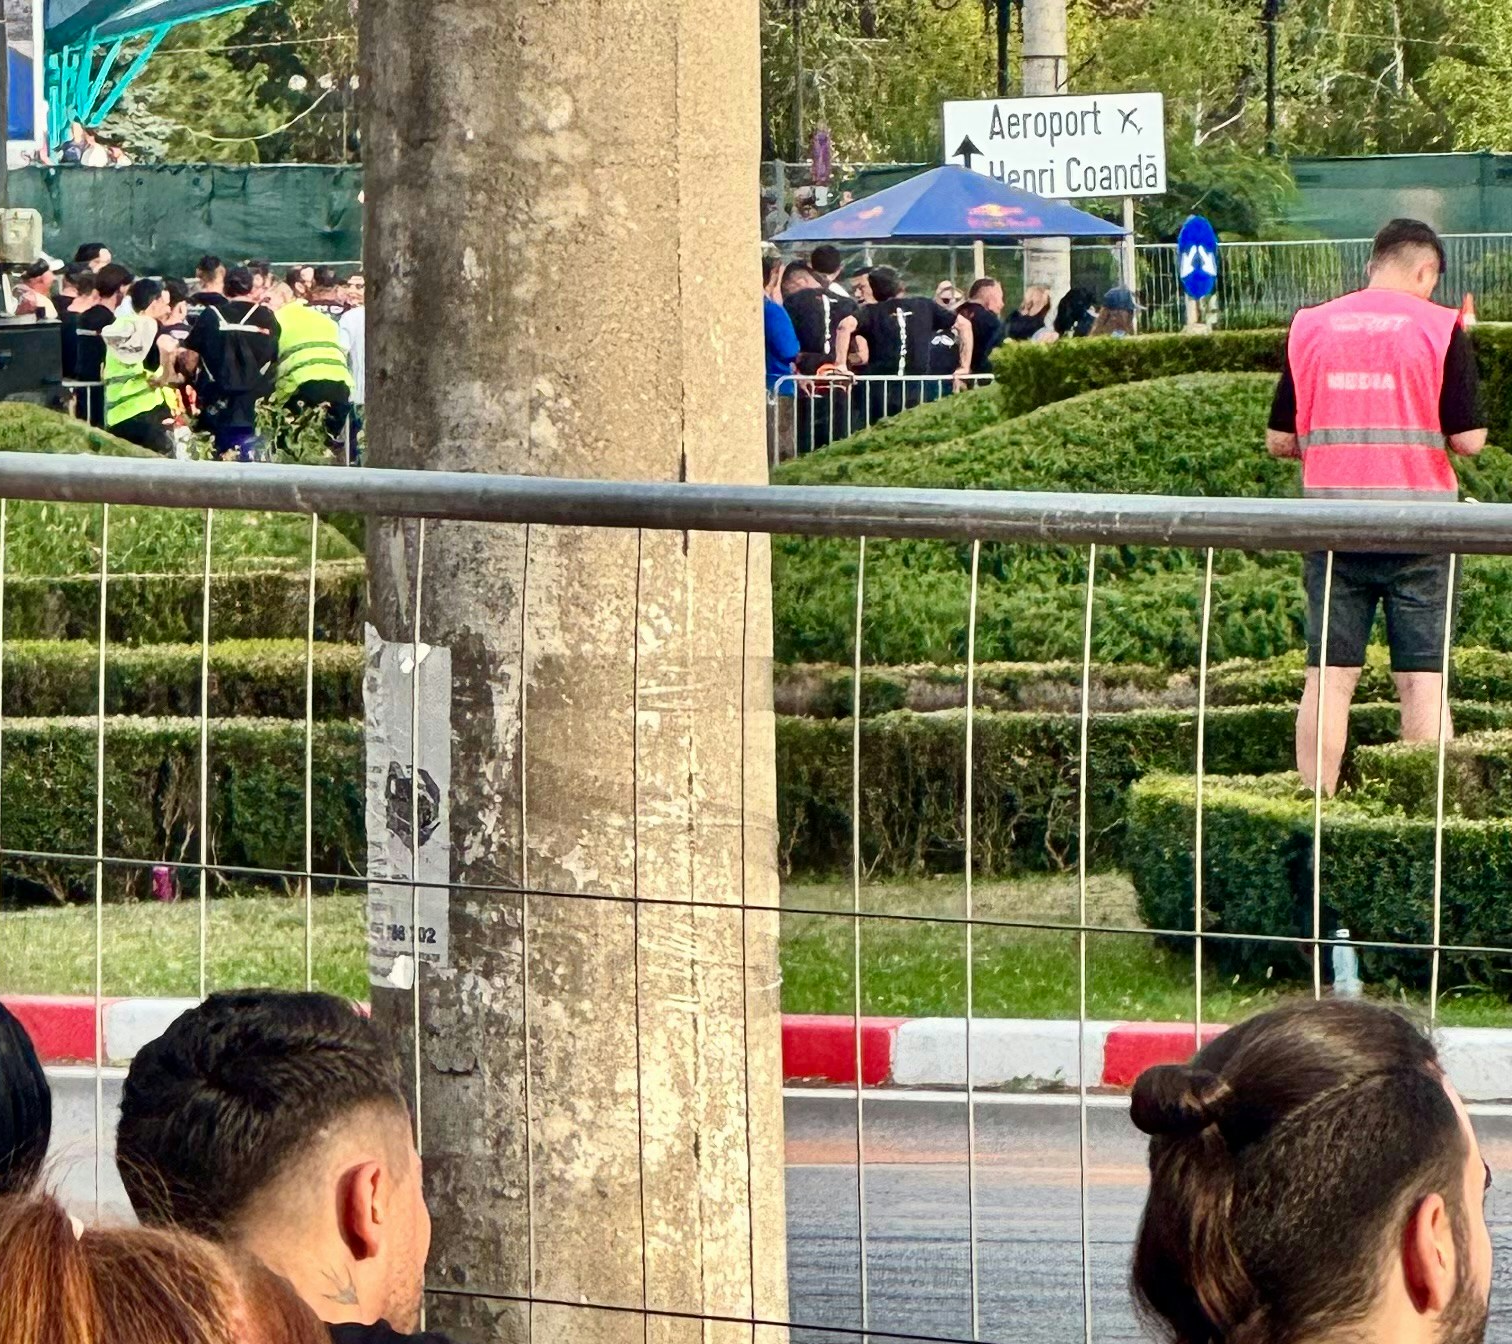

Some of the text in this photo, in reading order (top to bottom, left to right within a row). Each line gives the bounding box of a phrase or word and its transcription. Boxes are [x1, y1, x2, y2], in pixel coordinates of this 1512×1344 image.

[989, 101, 1102, 147] Aeroport
[989, 154, 1158, 195] Henri Coandă
